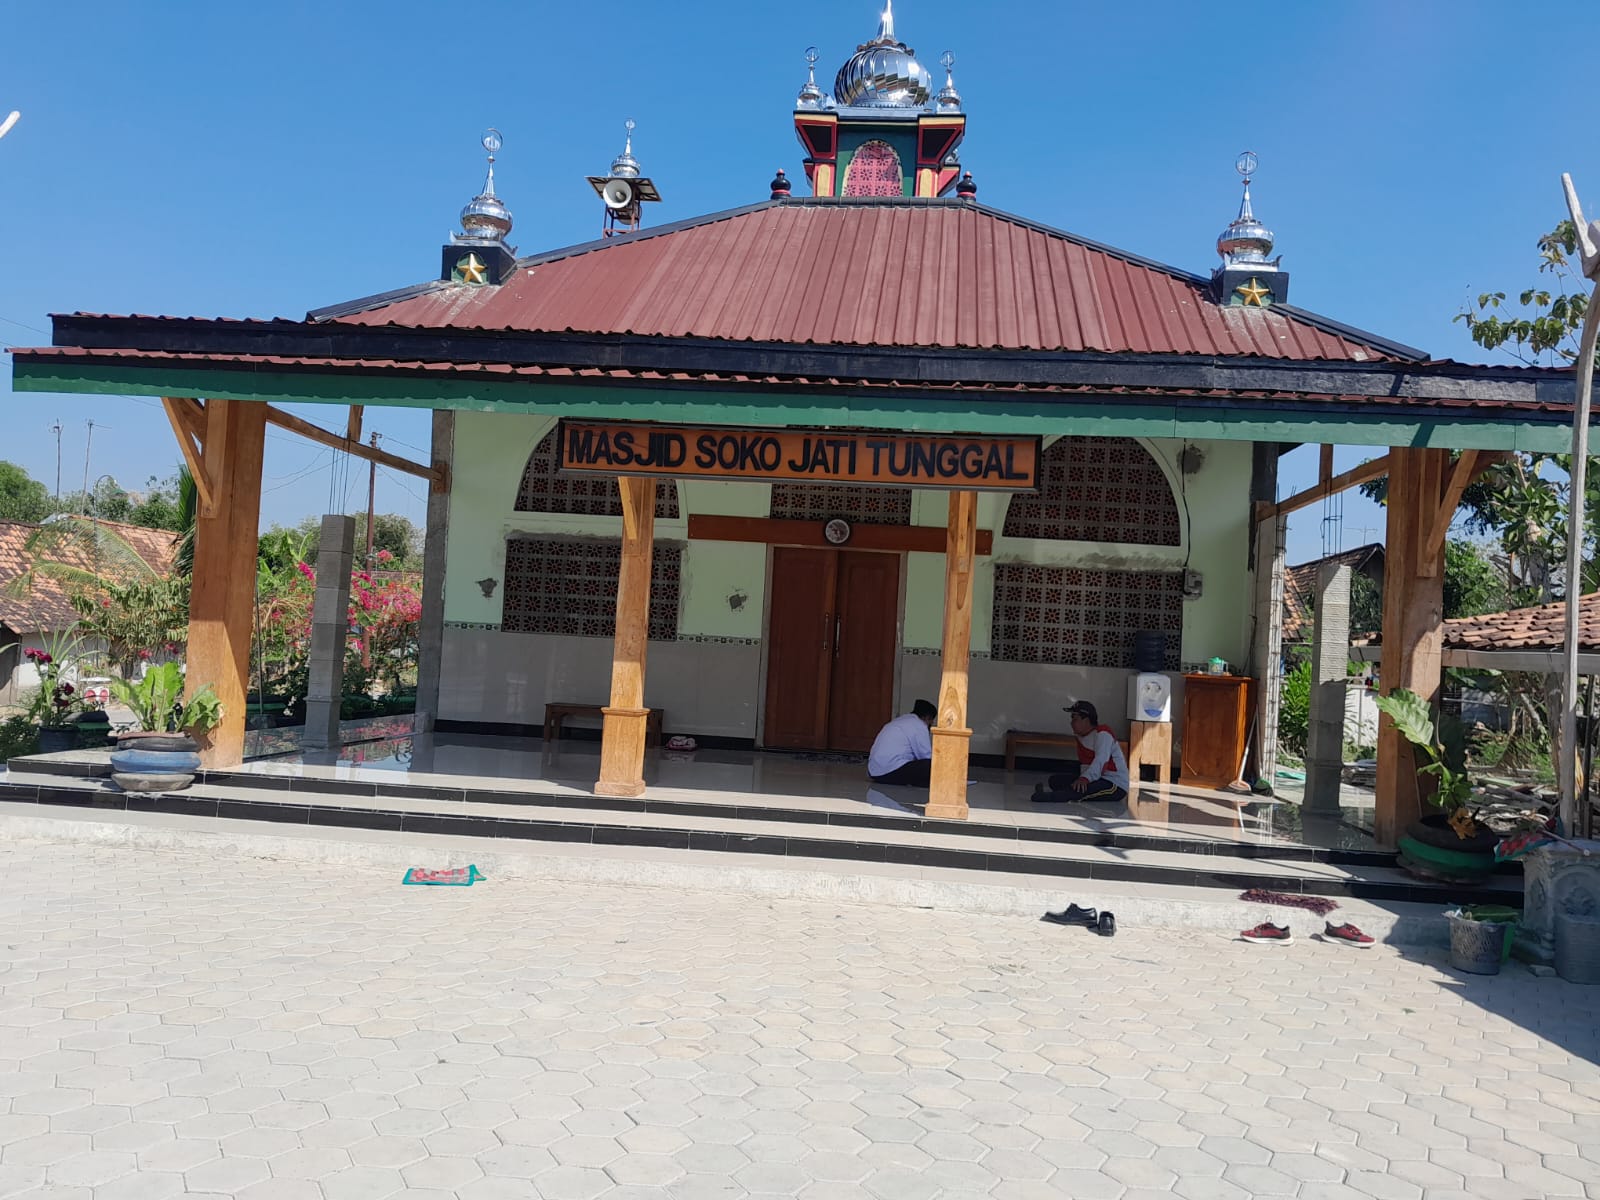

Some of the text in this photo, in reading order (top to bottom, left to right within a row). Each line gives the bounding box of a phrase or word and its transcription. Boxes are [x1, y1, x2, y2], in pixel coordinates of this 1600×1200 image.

[568, 429, 1029, 480] MASJID SOKO JATI TUNGGAL
